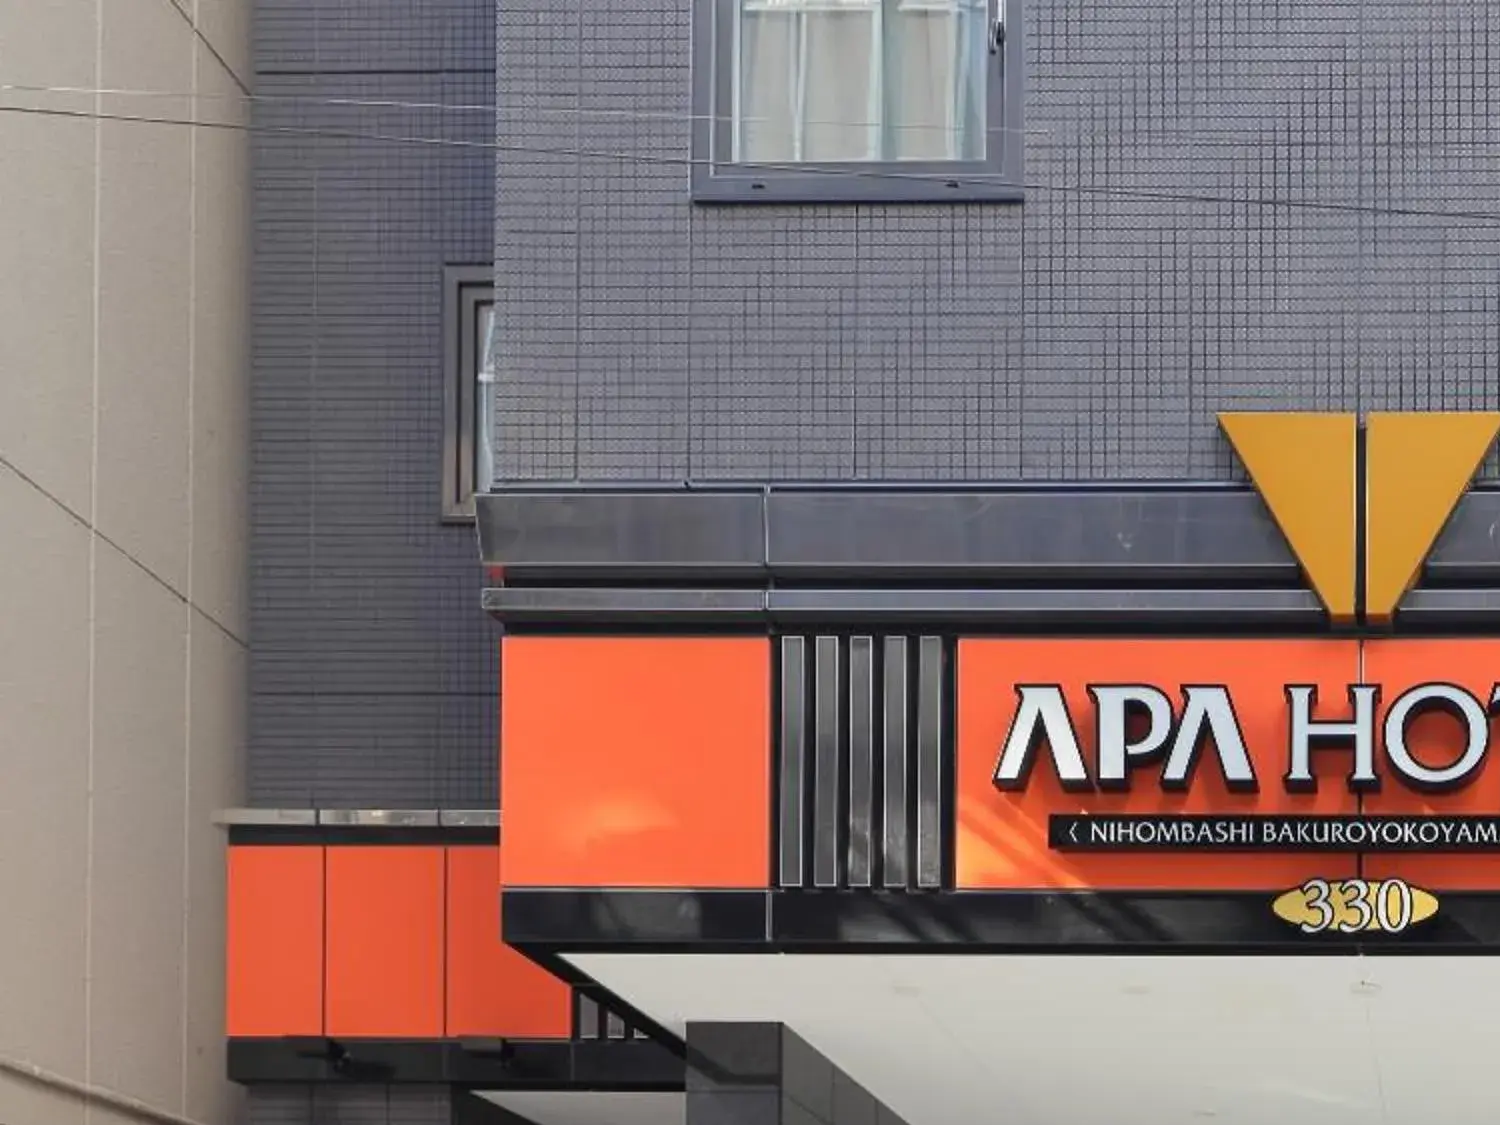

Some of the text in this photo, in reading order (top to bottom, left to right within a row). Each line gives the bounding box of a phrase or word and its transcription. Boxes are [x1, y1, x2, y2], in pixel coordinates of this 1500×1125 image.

[994, 684, 1258, 789] APA
[1090, 821, 1255, 844] NIHOMBASHI
[1300, 880, 1413, 933] 330
